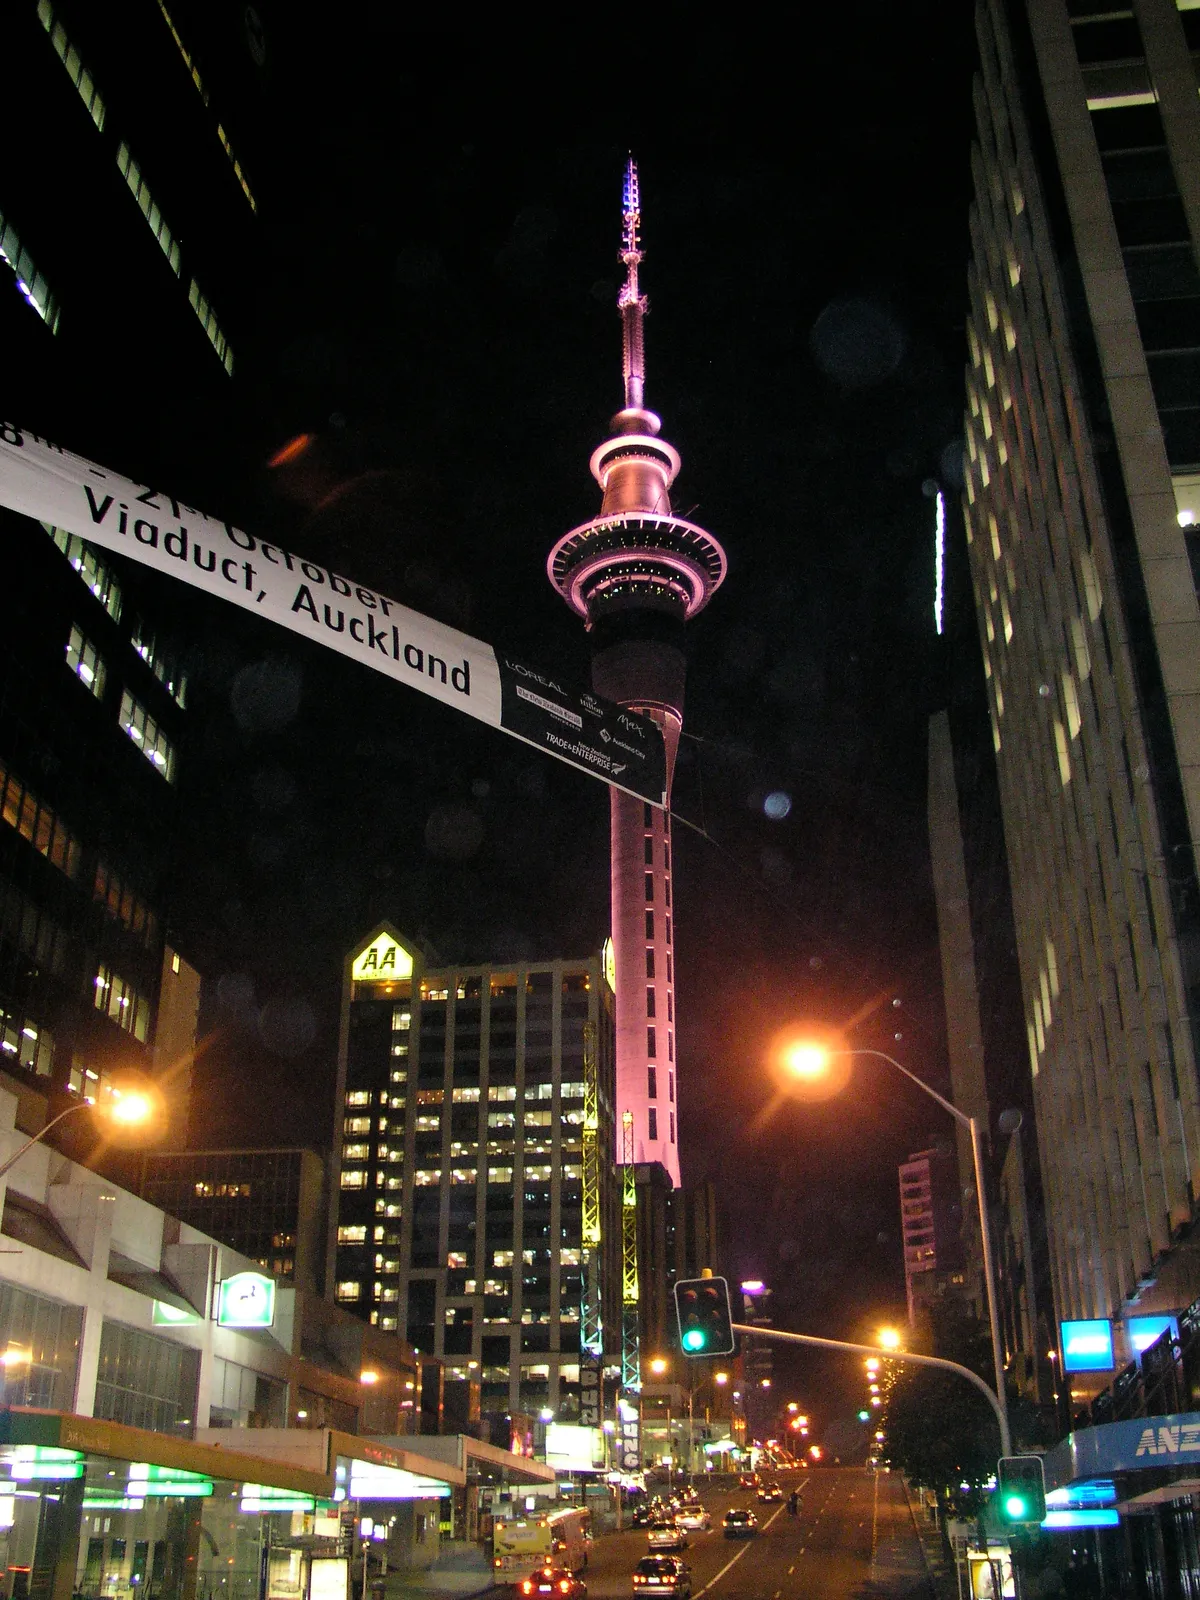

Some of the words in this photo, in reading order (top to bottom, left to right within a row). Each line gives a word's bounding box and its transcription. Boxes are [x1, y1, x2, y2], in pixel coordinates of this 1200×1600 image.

[83, 484, 267, 602] Viaduct,
[291, 583, 471, 696] Auckland
[361, 947, 396, 970] AA
[1135, 1423, 1200, 1456] ANZ
